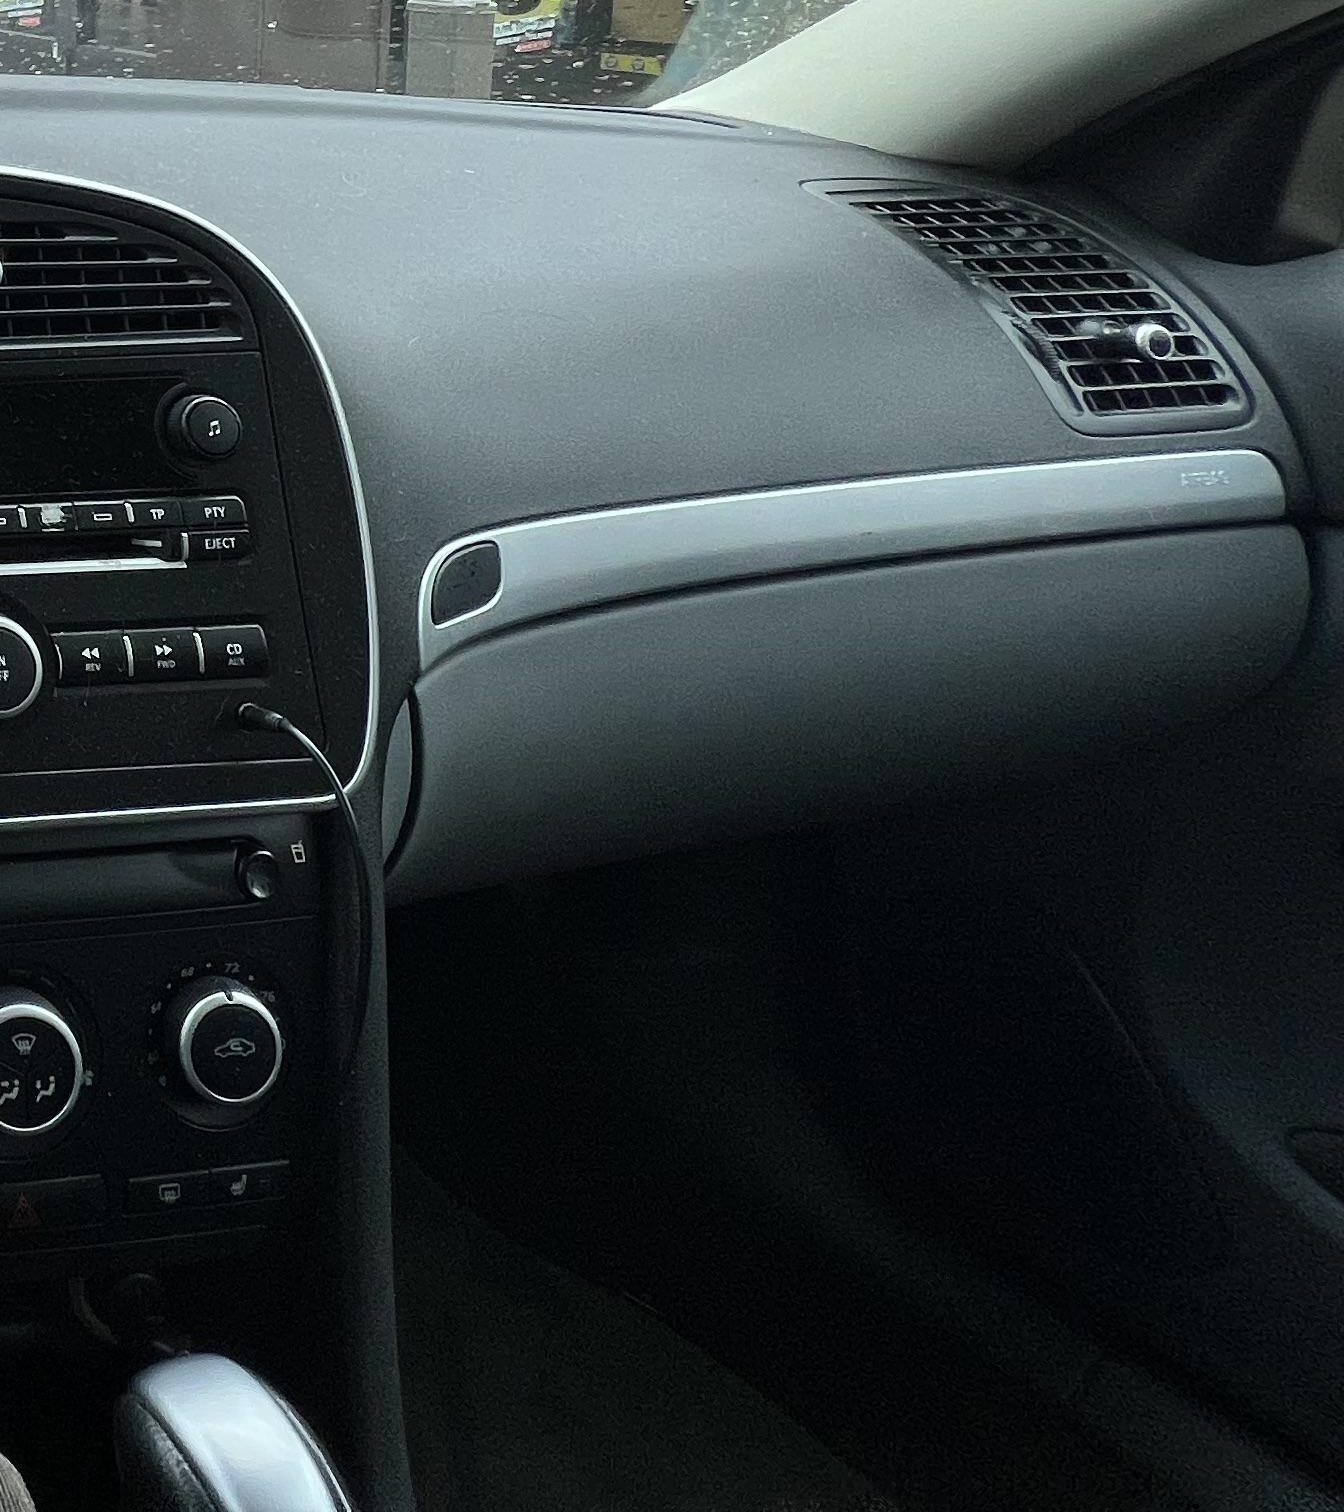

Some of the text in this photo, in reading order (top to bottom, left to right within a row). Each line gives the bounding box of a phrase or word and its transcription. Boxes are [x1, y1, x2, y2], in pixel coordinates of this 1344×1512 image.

[149, 509, 165, 521] TP
[204, 506, 226, 519] PTY
[205, 537, 236, 550] EJECT
[226, 643, 243, 656] CD
[224, 961, 241, 974] 72
